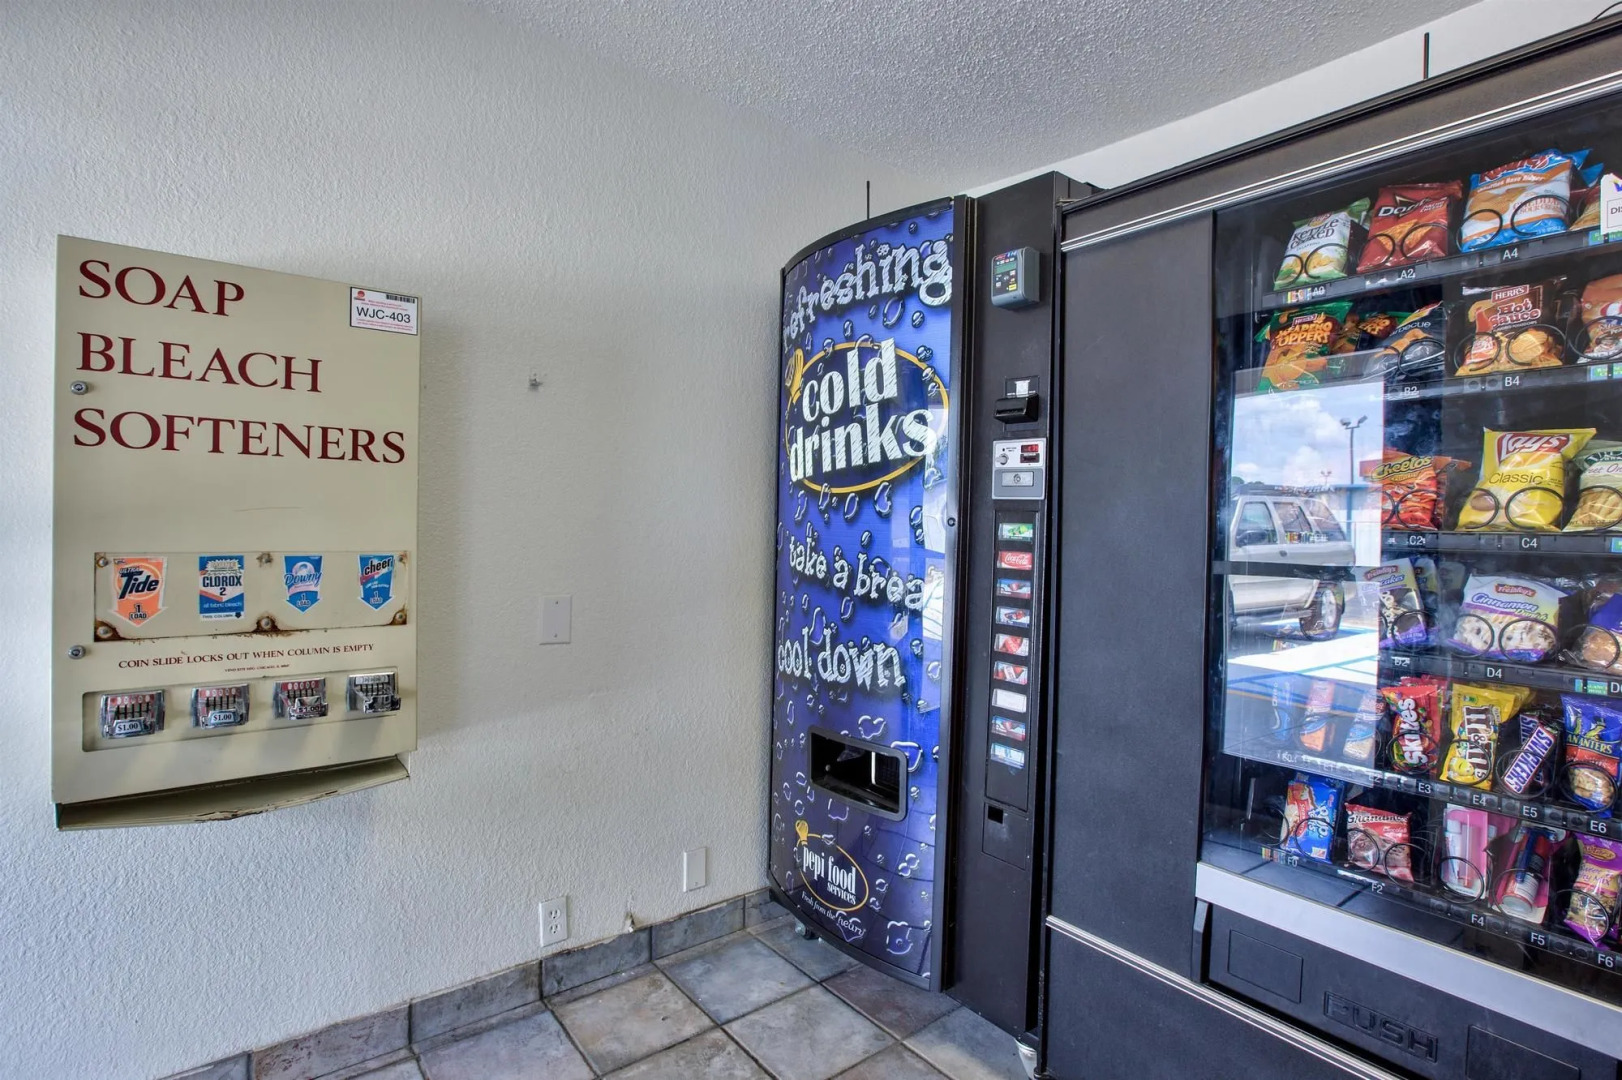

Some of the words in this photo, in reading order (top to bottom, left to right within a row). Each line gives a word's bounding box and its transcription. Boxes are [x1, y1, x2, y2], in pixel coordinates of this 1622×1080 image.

[1503, 248, 1518, 260] A4
[1400, 269, 1413, 280] A2
[78, 259, 245, 317] SOAP
[783, 240, 953, 347] refreshing
[1495, 288, 1525, 300] HERR'S
[1497, 299, 1532, 314] Hot
[356, 306, 411, 324] WJC-403
[1489, 309, 1541, 328] Sauce
[76, 331, 322, 393] BLEACH
[802, 338, 898, 422] cold
[1505, 376, 1520, 387] B4
[1404, 386, 1418, 396] B2
[73, 408, 405, 464] SOFTENERS
[789, 402, 938, 483] drinks
[1373, 456, 1432, 479] Cheetos
[1489, 473, 1543, 485] Classic
[1409, 535, 1423, 546] C2
[1521, 537, 1537, 548] C4
[364, 558, 393, 576] cheer
[790, 535, 827, 579] take
[833, 556, 851, 590] a
[854, 553, 924, 611] brea
[118, 571, 160, 600] Tide
[202, 575, 242, 588] CLOROX
[284, 572, 322, 587] Downy
[219, 587, 227, 596] 2
[301, 592, 306, 600] 1
[374, 590, 379, 598] 1
[134, 604, 141, 613] 1
[1472, 593, 1539, 612] Cinnamon
[129, 612, 147, 620] LOAD
[1514, 608, 1548, 622] Danish
[118, 659, 149, 669] COIN
[153, 656, 183, 666] SLIDE
[187, 653, 223, 664] LOCKS
[226, 651, 250, 662] OUT
[252, 649, 284, 660] WHEN
[287, 646, 330, 657] COLUMN
[332, 645, 341, 653] IS
[343, 643, 374, 653] EMPTY
[778, 628, 812, 680] cool
[817, 628, 906, 691] down
[1487, 668, 1502, 678] D4
[213, 713, 232, 721] $1.00
[117, 722, 138, 731] $1.00
[1504, 726, 1553, 793] SNICKERS
[1418, 783, 1431, 794] E3
[1472, 794, 1487, 807] E4
[1523, 806, 1537, 818] E5
[1590, 820, 1607, 833] E6
[1287, 857, 1298, 867] F0
[803, 845, 825, 880] pepi
[827, 855, 856, 894] food
[826, 882, 857, 905] services
[1371, 884, 1383, 894] F2
[813, 901, 826, 915] from
[826, 909, 836, 920] the
[1471, 914, 1485, 927] F4
[1530, 932, 1546, 946] F5
[1597, 953, 1614, 968] F6
[1326, 993, 1437, 1060] PUSH
